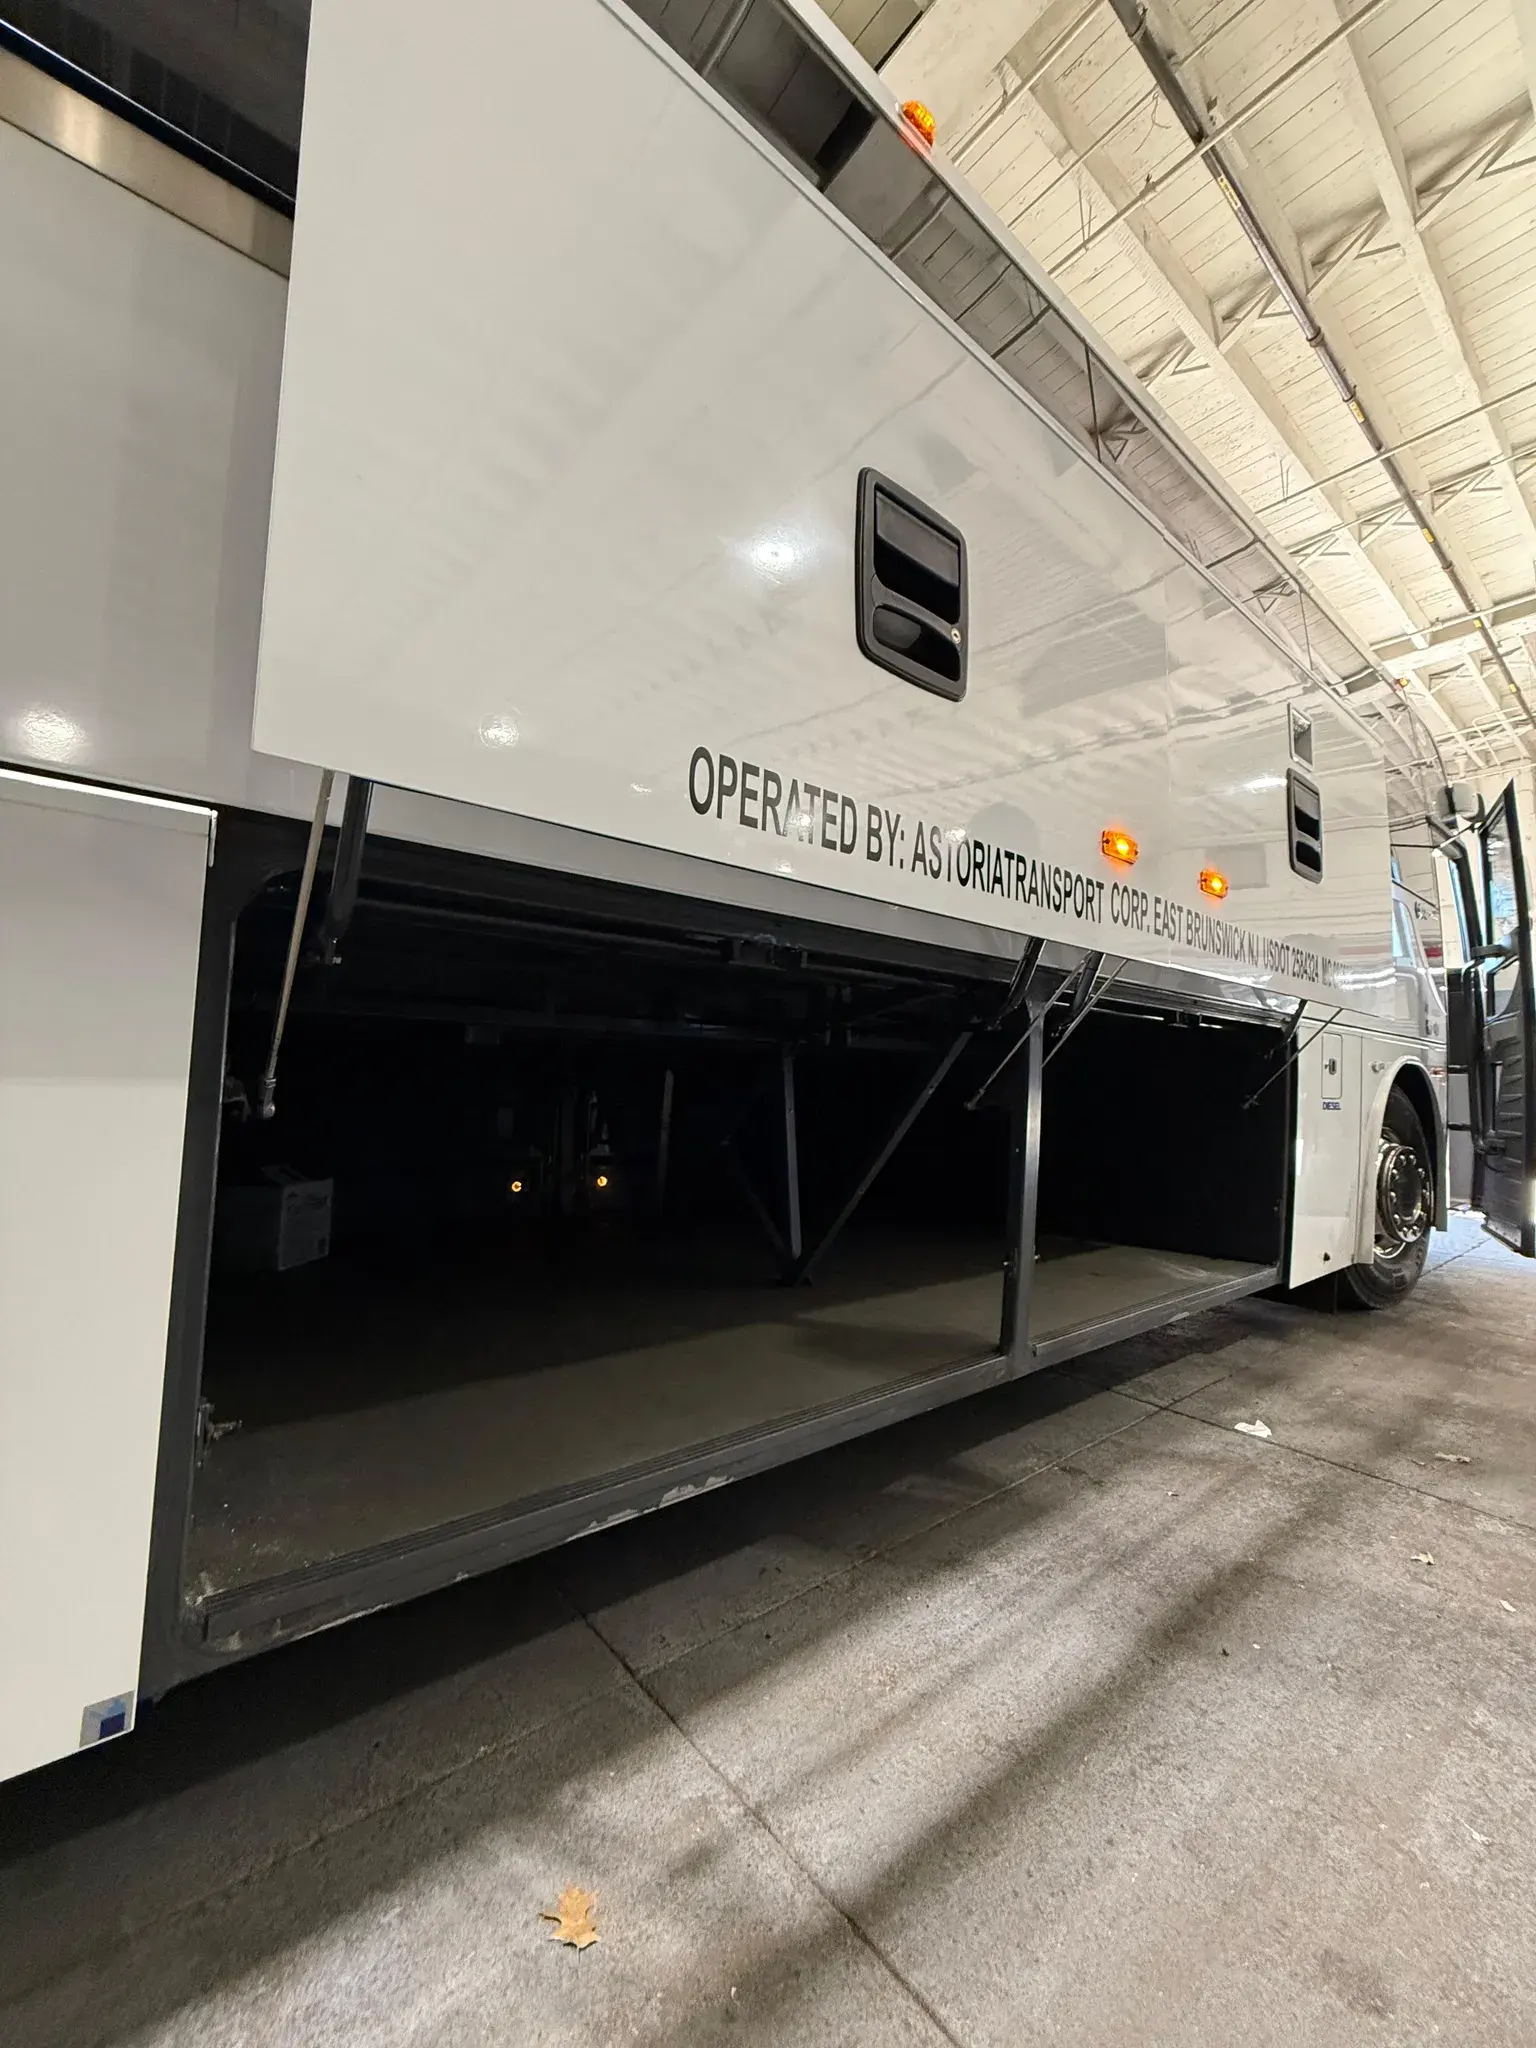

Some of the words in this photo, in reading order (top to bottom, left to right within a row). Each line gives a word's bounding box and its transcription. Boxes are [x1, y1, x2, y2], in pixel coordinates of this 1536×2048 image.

[689, 746, 858, 854] OPERATED
[867, 804, 904, 869] BY:
[1111, 882, 1150, 933] CORP.
[1154, 896, 1183, 943] EAST
[1186, 909, 1246, 963] BRUNSWICK
[1263, 937, 1290, 976] USDOT
[1322, 1102, 1341, 1110] DIESEL
